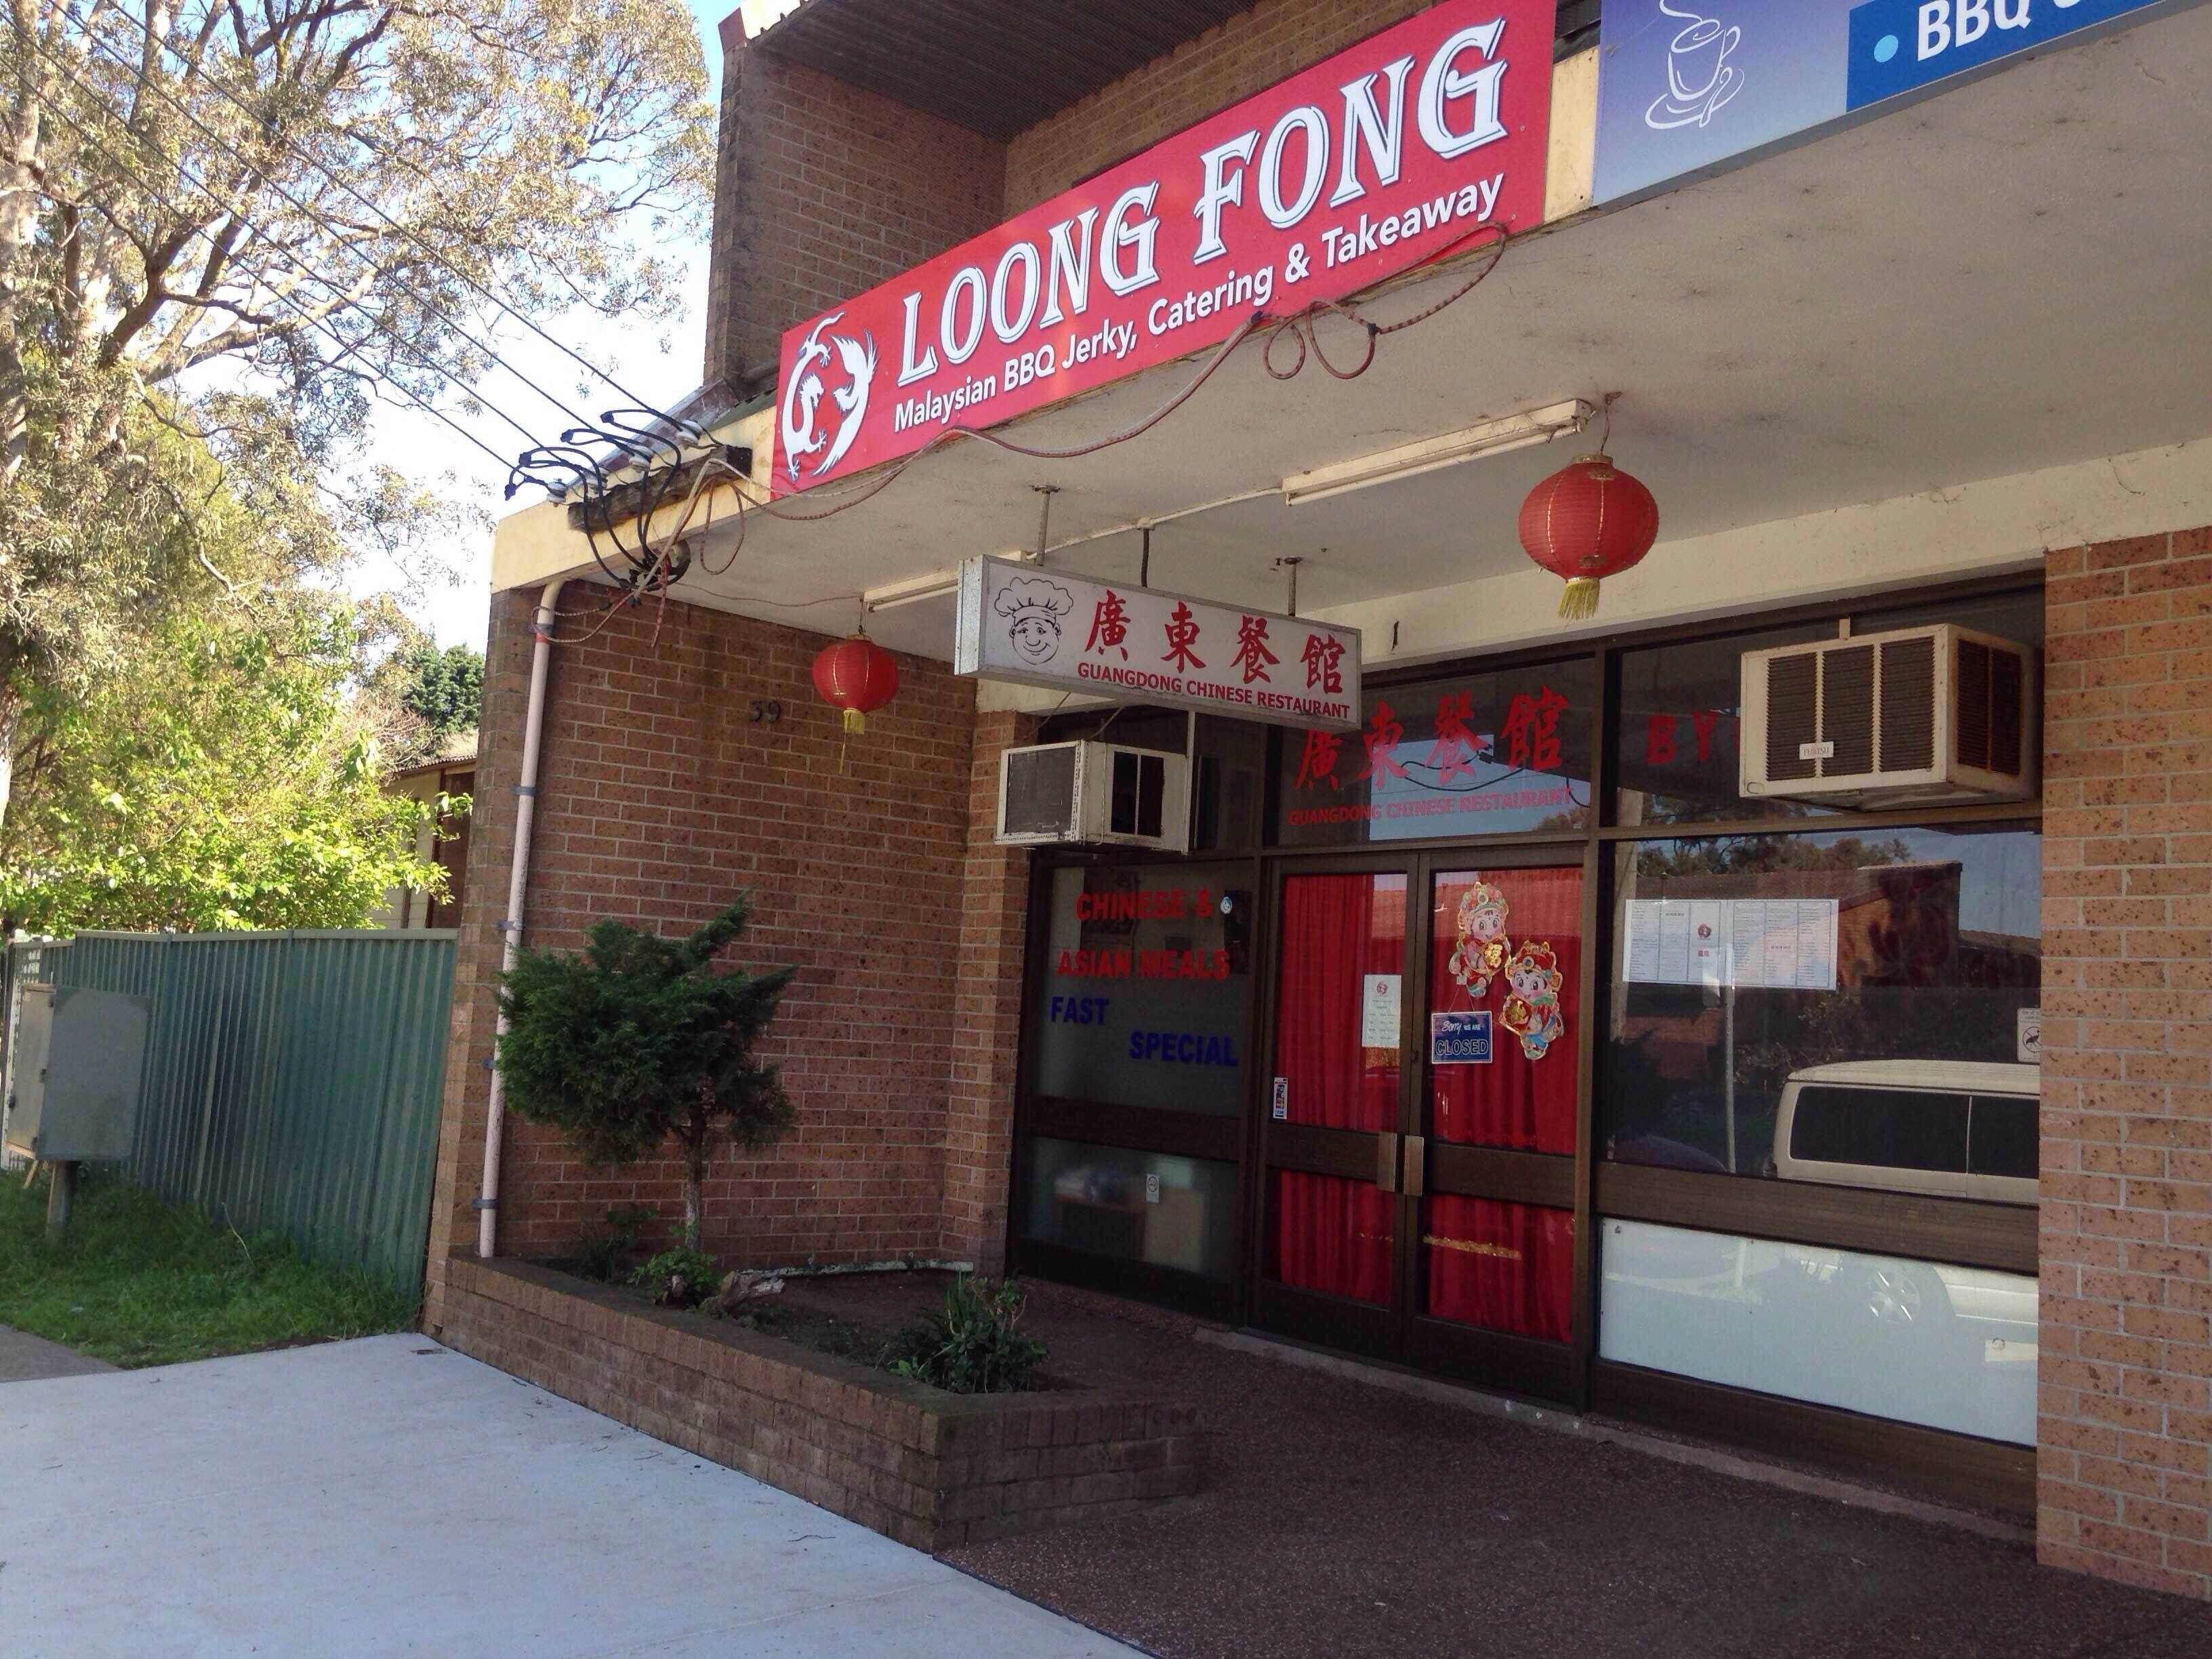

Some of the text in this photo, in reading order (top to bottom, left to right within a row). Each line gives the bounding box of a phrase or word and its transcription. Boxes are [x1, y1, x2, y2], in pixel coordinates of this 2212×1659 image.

[1917, 0, 2031, 61] BBQ
[897, 16, 1509, 388] LOONG FONG
[894, 172, 1504, 432] Malaysian BBQ Jerky, Catering & Takeaway
[1084, 589, 1346, 695] 廣東餐館
[1078, 661, 1351, 719] GUANGDONG CHINESE RESTAURANT
[1294, 685, 1570, 792] 廣東餐館
[1289, 787, 1574, 825] GUANGDONG CHINESE RESTAURANT
[1076, 889, 1214, 922] CHINESE &
[1057, 949, 1230, 980] ASIAN MEALS
[1050, 996, 1109, 1025] FAST
[1441, 1020, 1462, 1035] Sorry
[1129, 1030, 1239, 1067] SPECIAL
[1436, 1039, 1489, 1056] CLOSED
